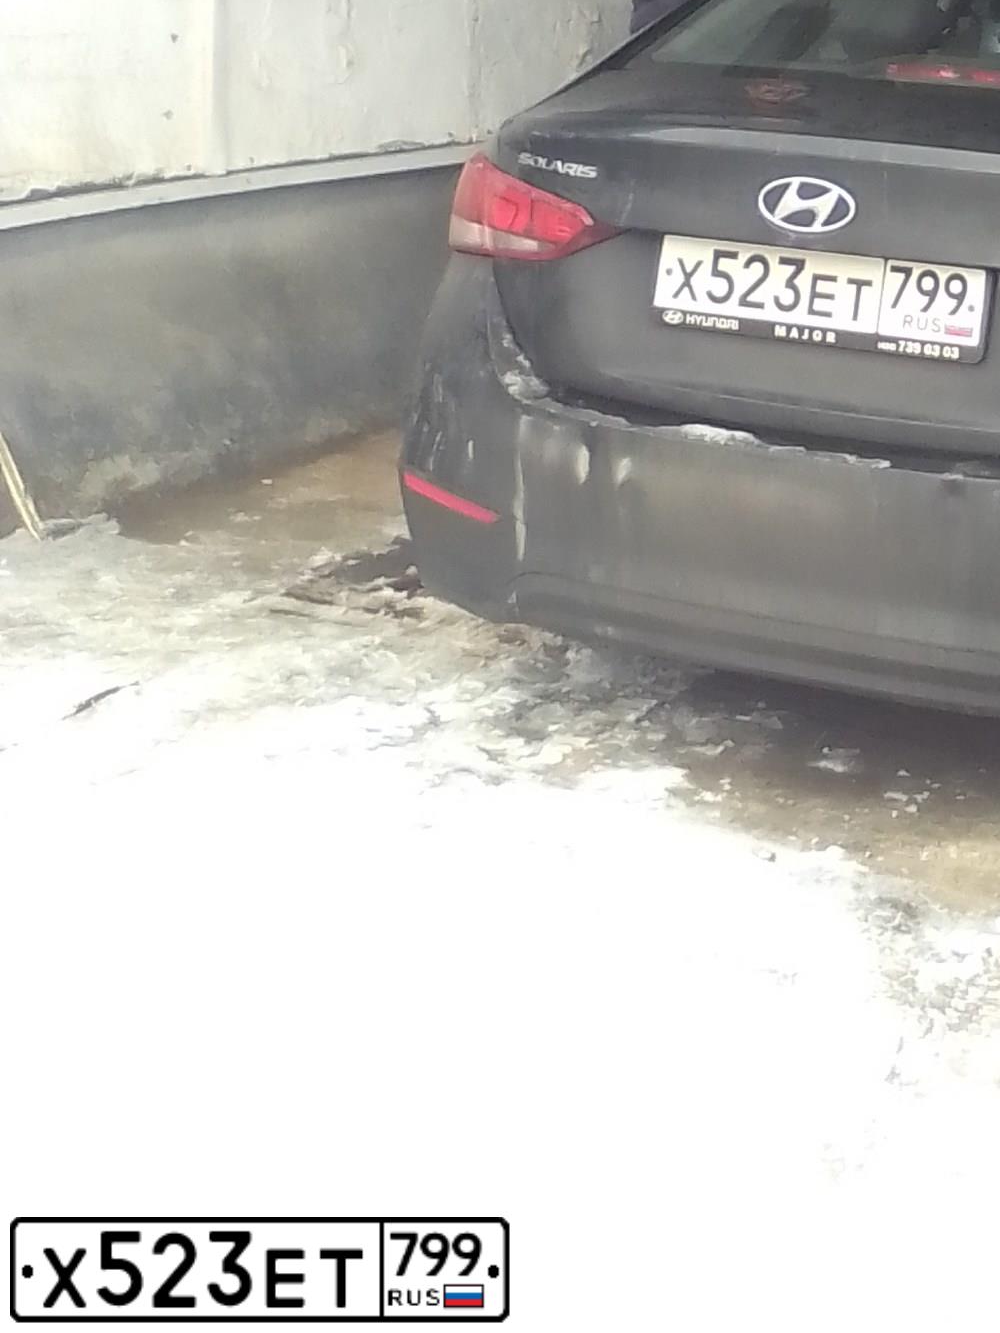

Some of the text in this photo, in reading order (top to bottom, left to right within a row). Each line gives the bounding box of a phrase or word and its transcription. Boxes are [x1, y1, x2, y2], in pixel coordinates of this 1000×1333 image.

[518, 151, 598, 179] SOLARIS
[889, 265, 969, 317] 799
[685, 316, 740, 331] HYUNDAI
[902, 314, 942, 334] RUS
[774, 324, 836, 344] MAJOR
